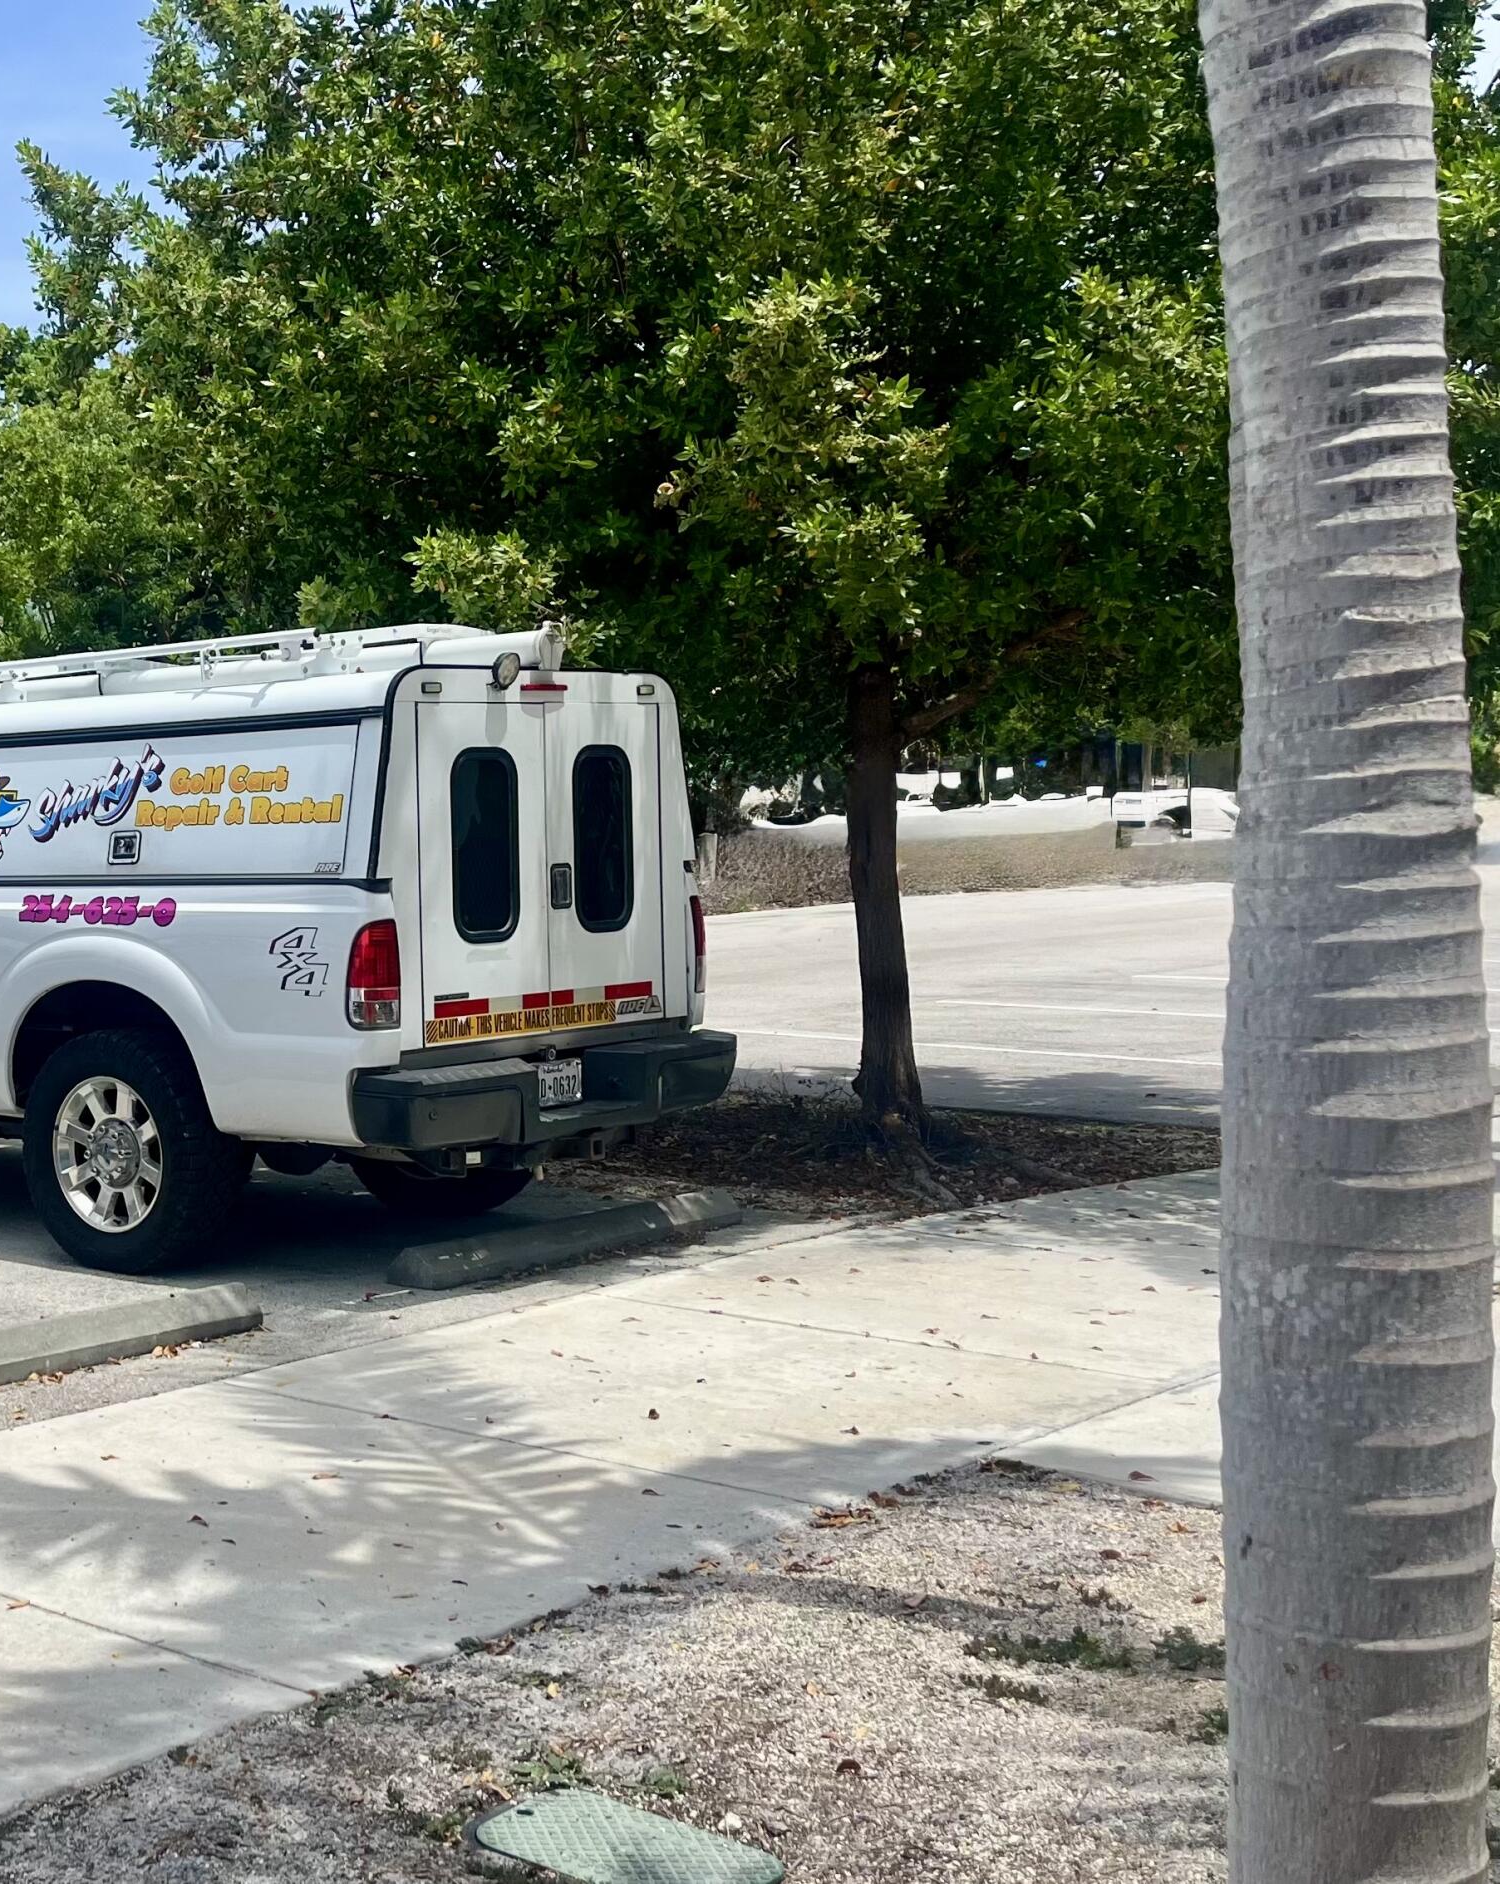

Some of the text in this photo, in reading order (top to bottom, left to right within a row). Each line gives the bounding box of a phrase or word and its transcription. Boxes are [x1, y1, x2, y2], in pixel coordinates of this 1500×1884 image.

[169, 765, 289, 797] Golf Cart
[134, 794, 344, 831] Repair & Rental
[18, 894, 177, 927] 254-625-0
[476, 1015, 492, 1035] THIS
[494, 1012, 522, 1033] VEHICLE
[524, 1009, 550, 1029] MAKES
[552, 1004, 585, 1026] FREQUENT
[587, 1001, 609, 1022] STOPS
